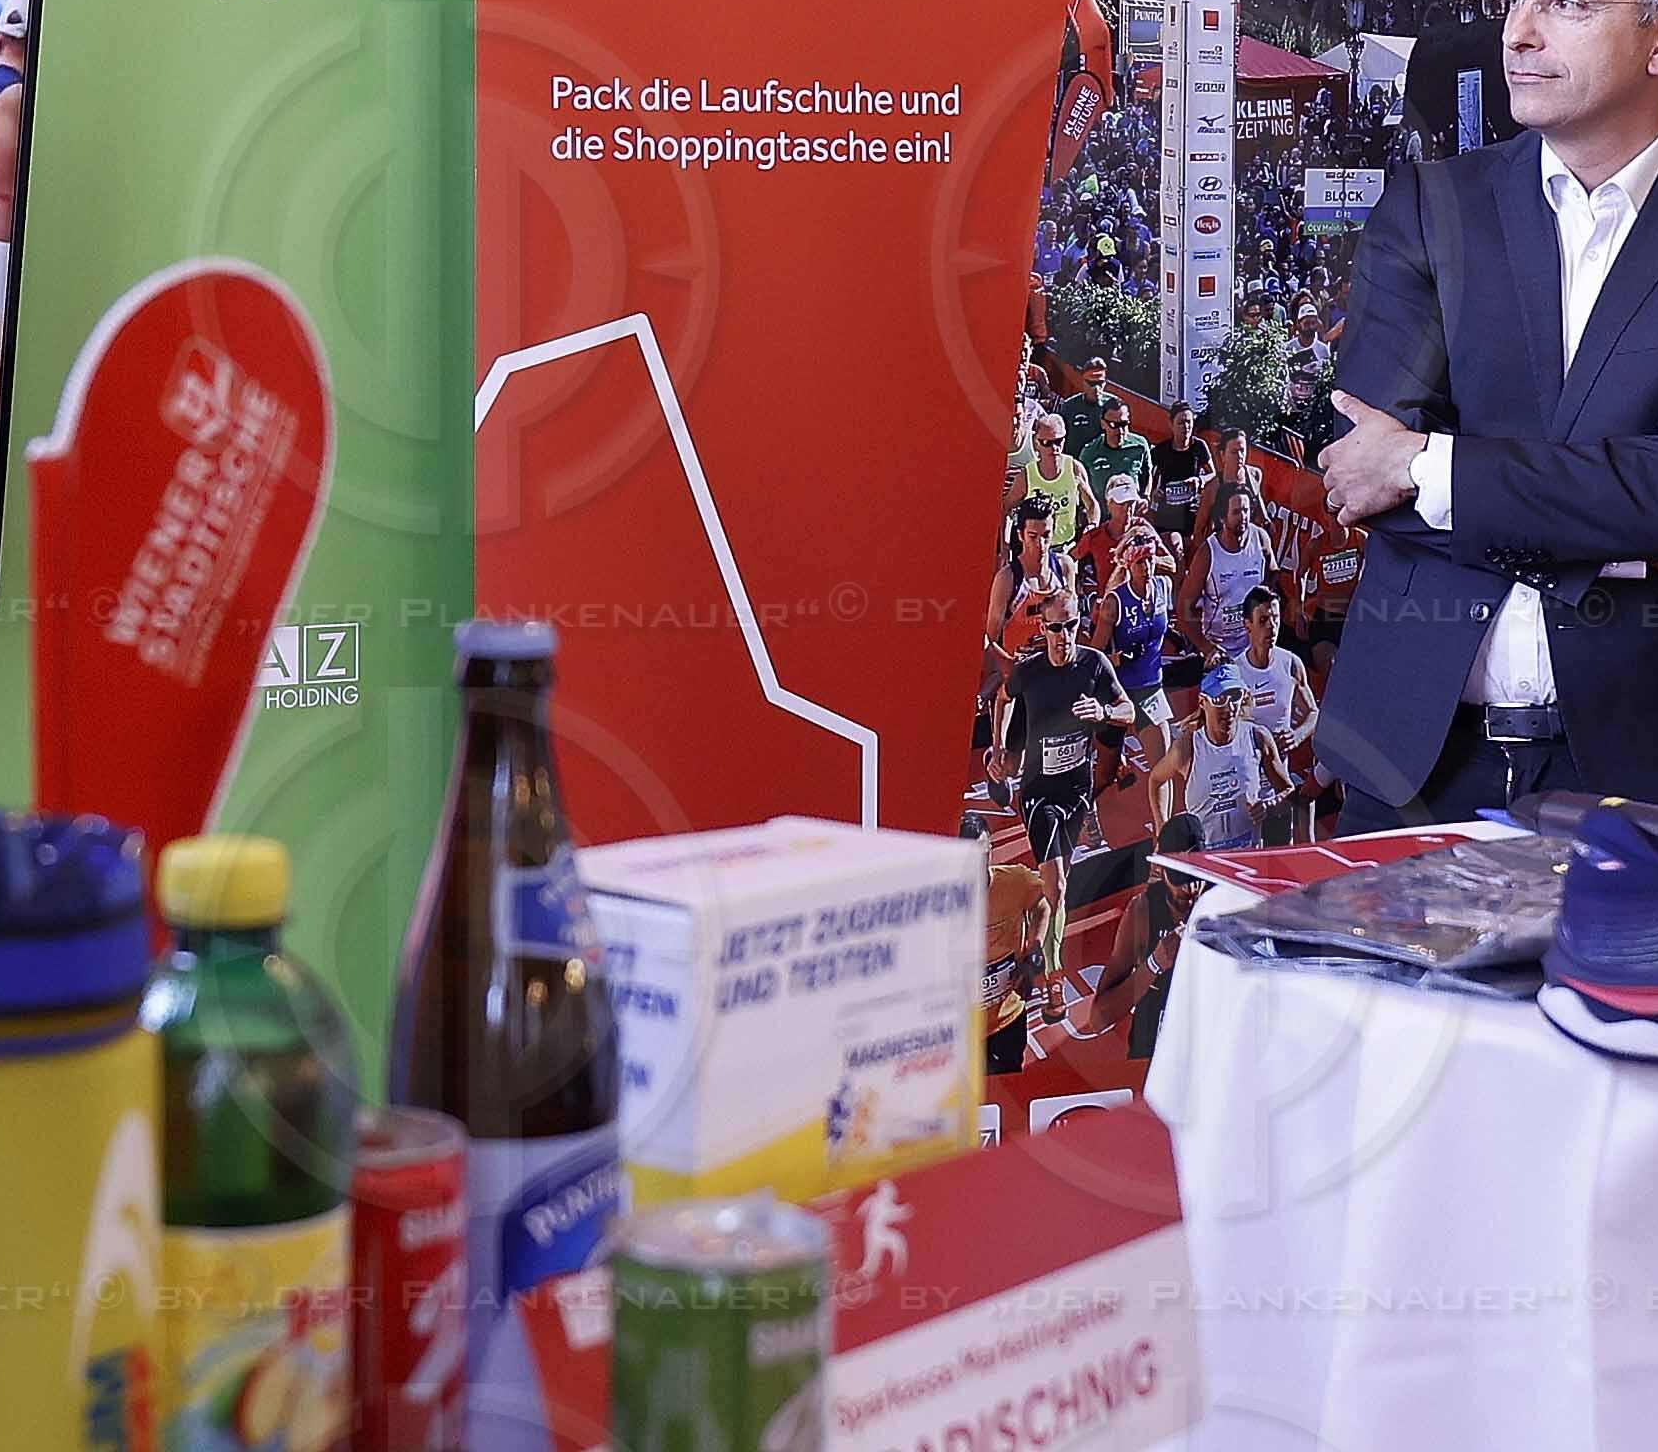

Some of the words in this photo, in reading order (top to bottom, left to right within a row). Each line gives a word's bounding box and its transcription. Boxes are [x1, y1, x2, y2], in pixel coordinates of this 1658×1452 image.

[551, 77, 632, 113] Pack
[640, 79, 691, 114] die
[700, 78, 893, 115] Laufschuhe
[901, 84, 960, 116] und
[1063, 85, 1092, 136] KLEINE
[1236, 98, 1293, 118] KLEINE
[1072, 92, 1100, 141] ZEITUNG
[551, 127, 604, 160] die
[613, 128, 887, 171] Shoppingtasche
[895, 132, 951, 164] ein!
[1324, 190, 1364, 202] BLOCK
[266, 685, 359, 710] HOLDING
